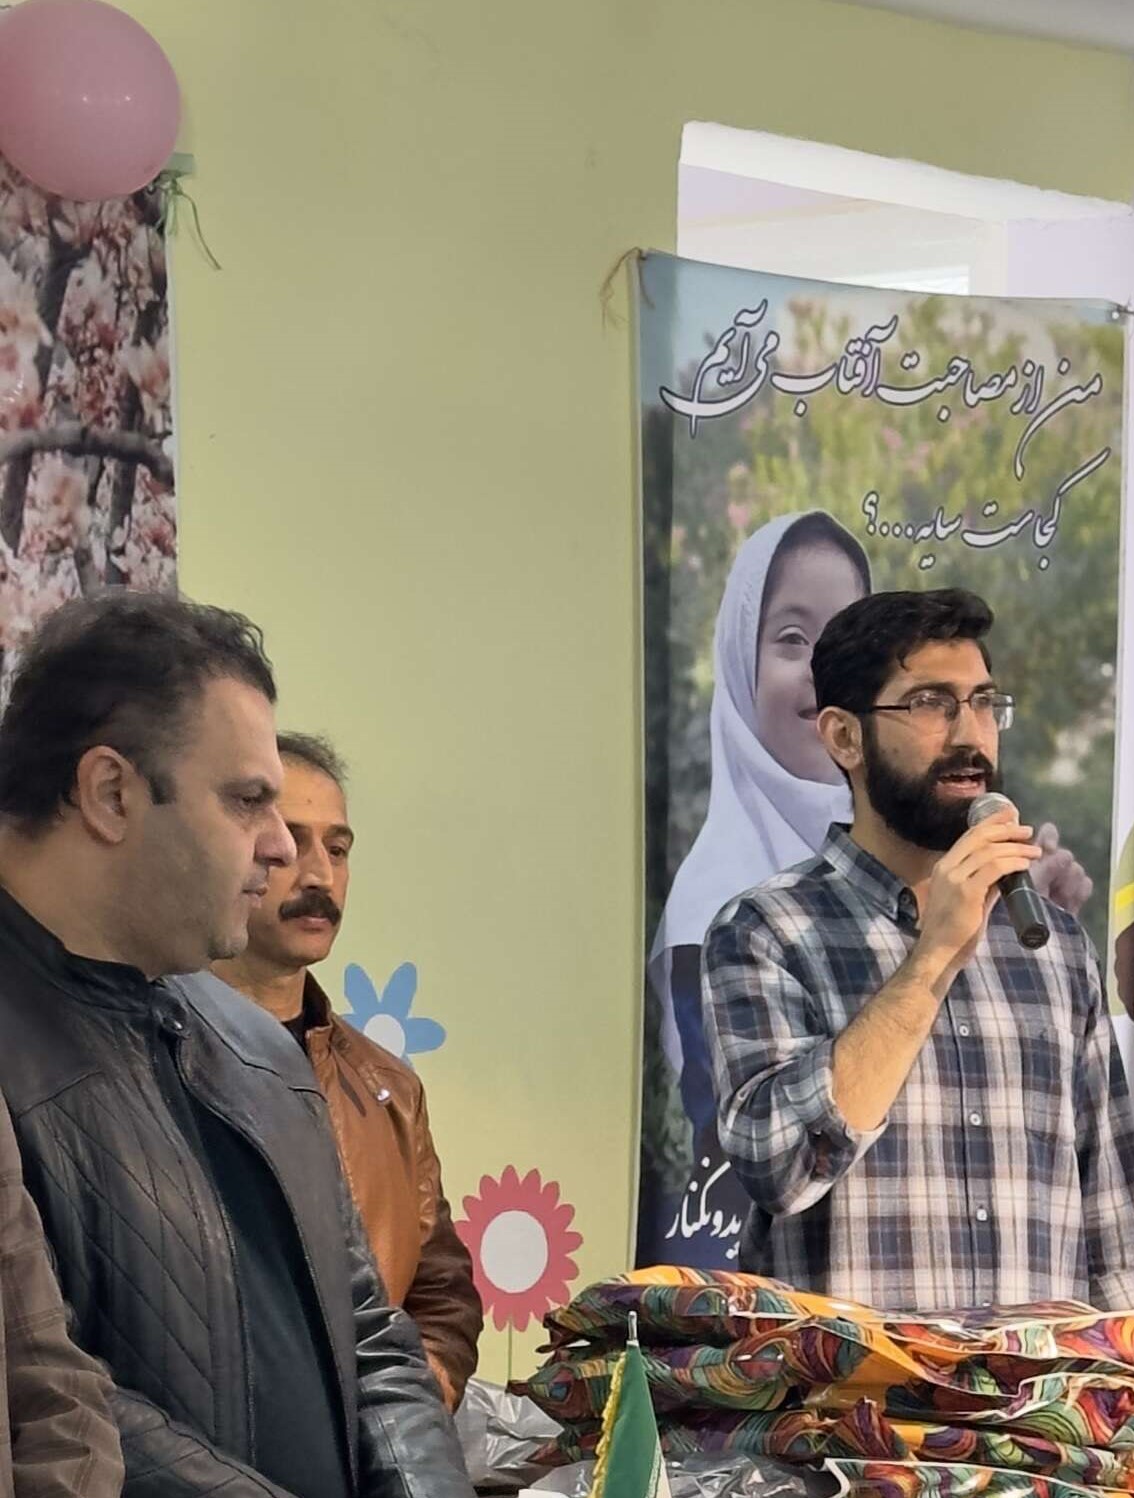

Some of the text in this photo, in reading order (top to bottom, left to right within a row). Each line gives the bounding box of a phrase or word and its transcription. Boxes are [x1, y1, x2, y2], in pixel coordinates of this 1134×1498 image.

[769, 314, 899, 417] آفتاب
[875, 350, 1018, 422] مصاحبت
[1010, 359, 1044, 415] از
[1014, 357, 1103, 481] من
[961, 447, 1111, 571] کجاست
